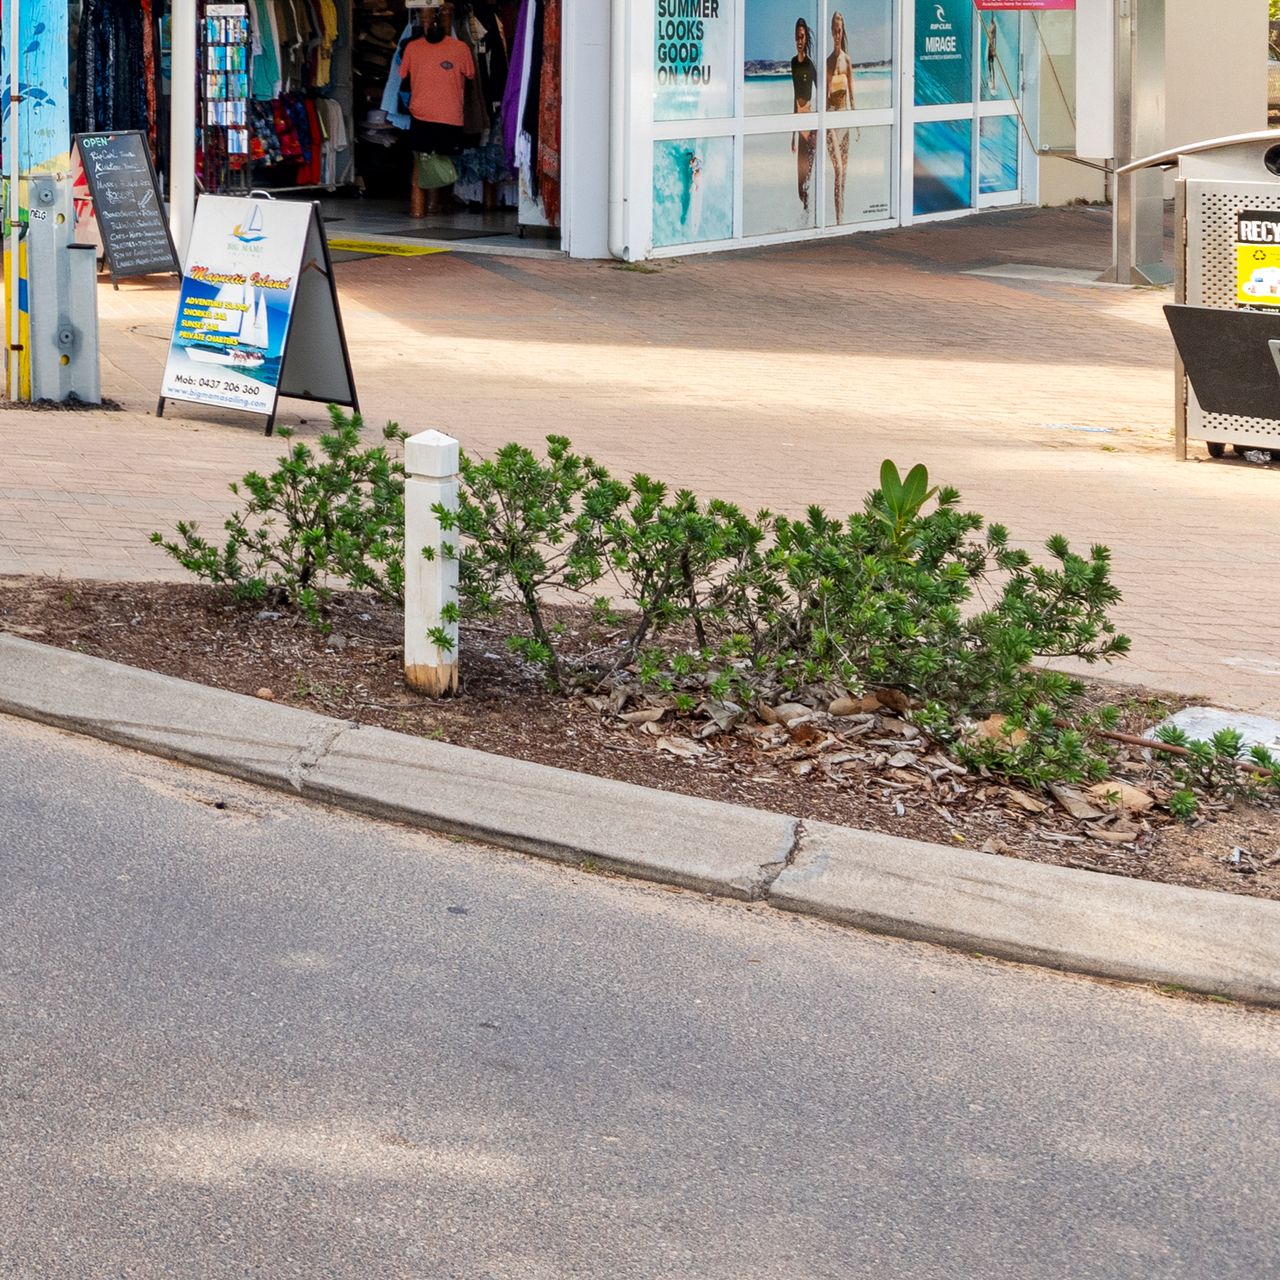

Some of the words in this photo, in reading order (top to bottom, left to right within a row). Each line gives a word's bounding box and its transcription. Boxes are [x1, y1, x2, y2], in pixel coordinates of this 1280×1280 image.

[658, 20, 704, 41] LOOKS
[657, 42, 699, 63] GOOD
[925, 36, 957, 53] MIRAGE
[657, 65, 678, 85] ON
[682, 65, 711, 85] YOU
[83, 136, 108, 148] OPEN
[191, 265, 247, 285] Magnetic
[250, 271, 292, 291] Island
[185, 297, 223, 308] ADVENTURE
[183, 308, 212, 319] SNORKEL
[214, 311, 227, 321] SAIL
[181, 320, 204, 330] SUNSET
[205, 322, 219, 331] SAIL
[179, 331, 205, 341] PRIVATE
[206, 335, 239, 346] CHARTERS
[174, 374, 196, 386] Mob:
[198, 378, 221, 389] 0437
[223, 382, 240, 392] 206
[242, 385, 260, 395] 360
[167, 387, 267, 408] www.bigmamasailing.com
